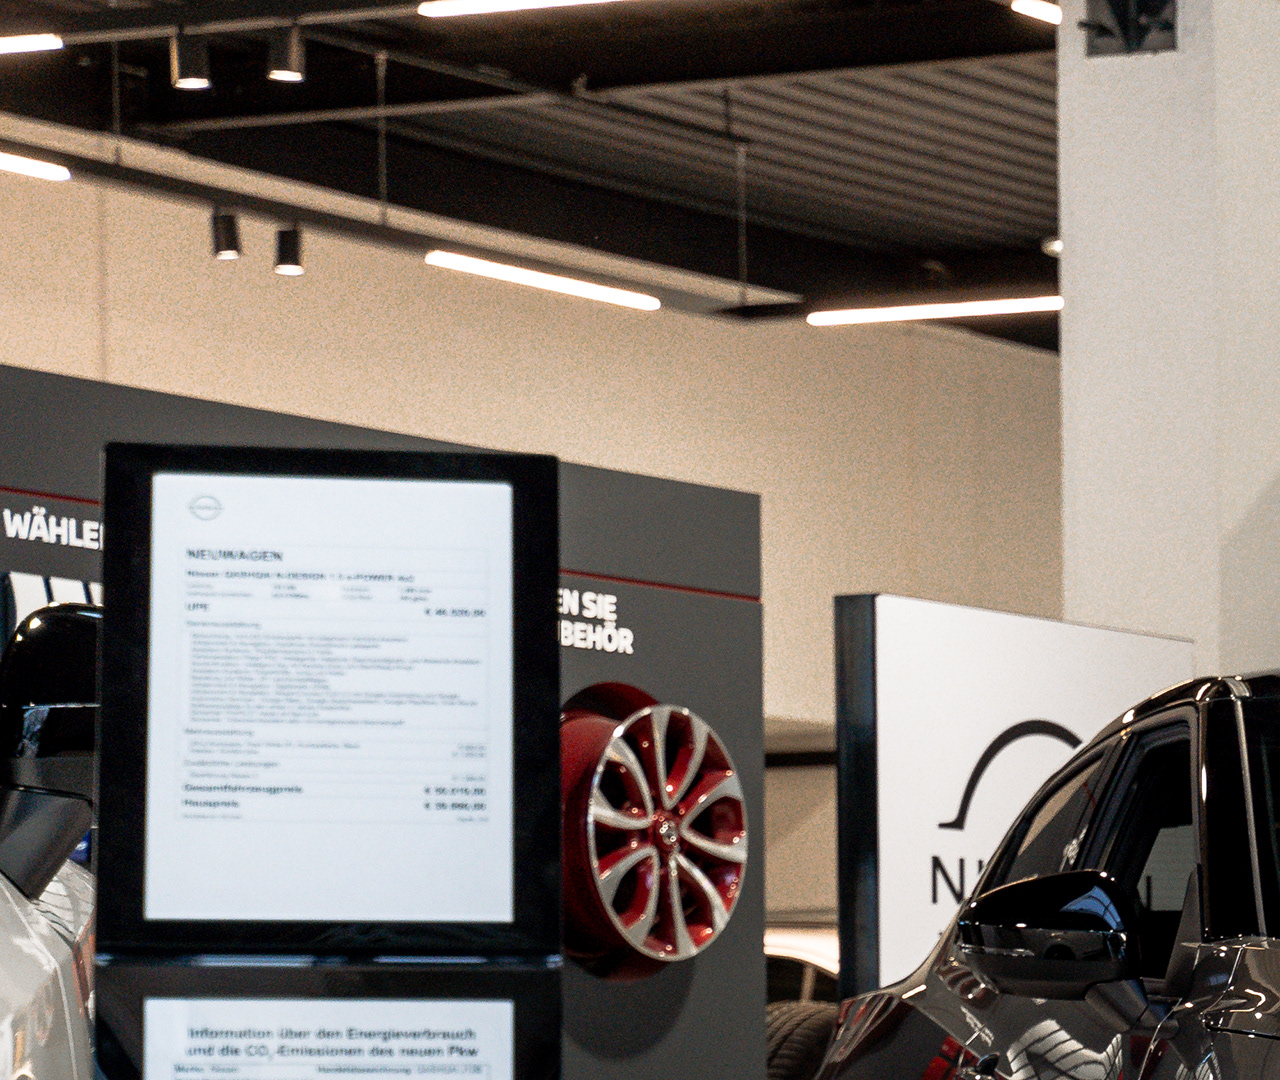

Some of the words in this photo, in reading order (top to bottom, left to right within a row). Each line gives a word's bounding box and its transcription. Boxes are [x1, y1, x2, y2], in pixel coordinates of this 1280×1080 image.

[3, 505, 103, 551] WÄHLE
[582, 591, 617, 621] SIE
[931, 856, 984, 905] N
[187, 1028, 274, 1040] Information
